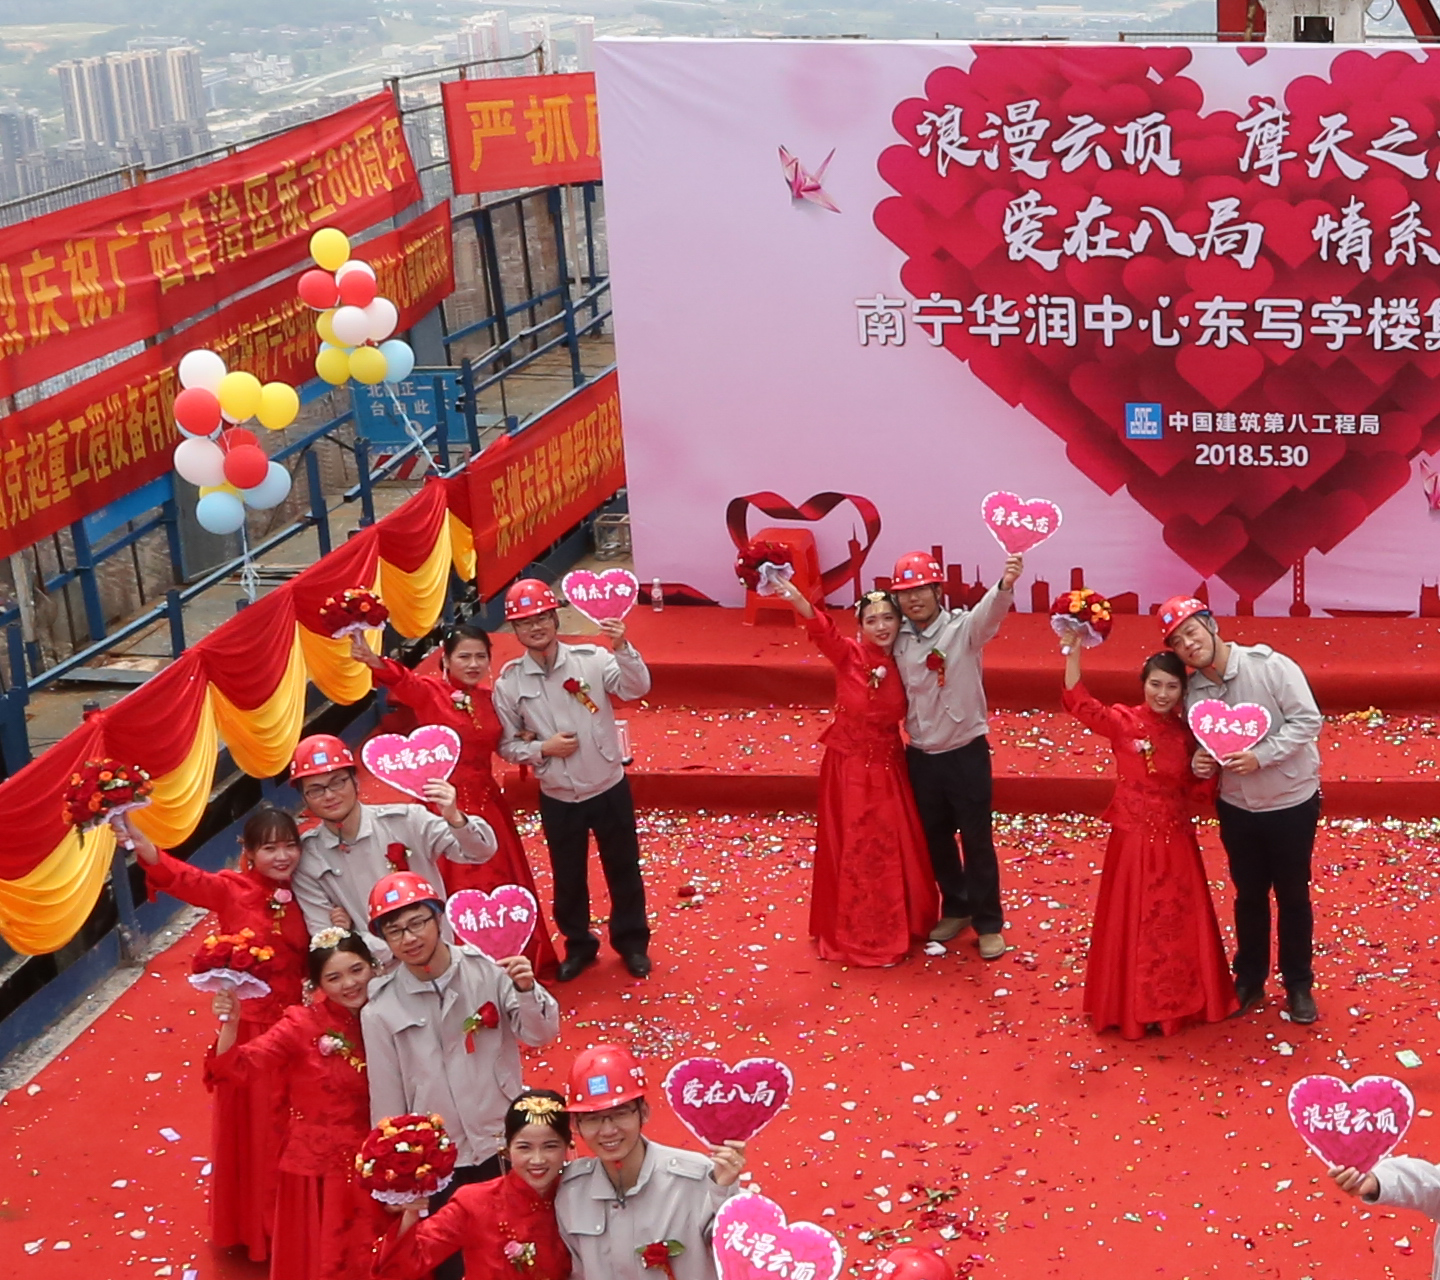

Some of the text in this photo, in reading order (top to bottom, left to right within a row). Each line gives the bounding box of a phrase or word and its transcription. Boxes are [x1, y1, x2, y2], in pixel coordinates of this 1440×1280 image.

[917, 99, 1181, 179] 浪漫云顶
[1001, 188, 1262, 273] 爱在八局
[1168, 411, 1380, 435] 中国建筑第八工程局
[1195, 444, 1308, 466] 2018.5.30
[992, 506, 1049, 534] 摩天之恋
[1199, 714, 1258, 737] 摩天之恋
[377, 744, 454, 774] 浪漫云顶
[458, 903, 529, 931] 情系广西
[682, 1078, 776, 1108] 爱在八局
[1302, 1102, 1399, 1135] 浪漫云顶
